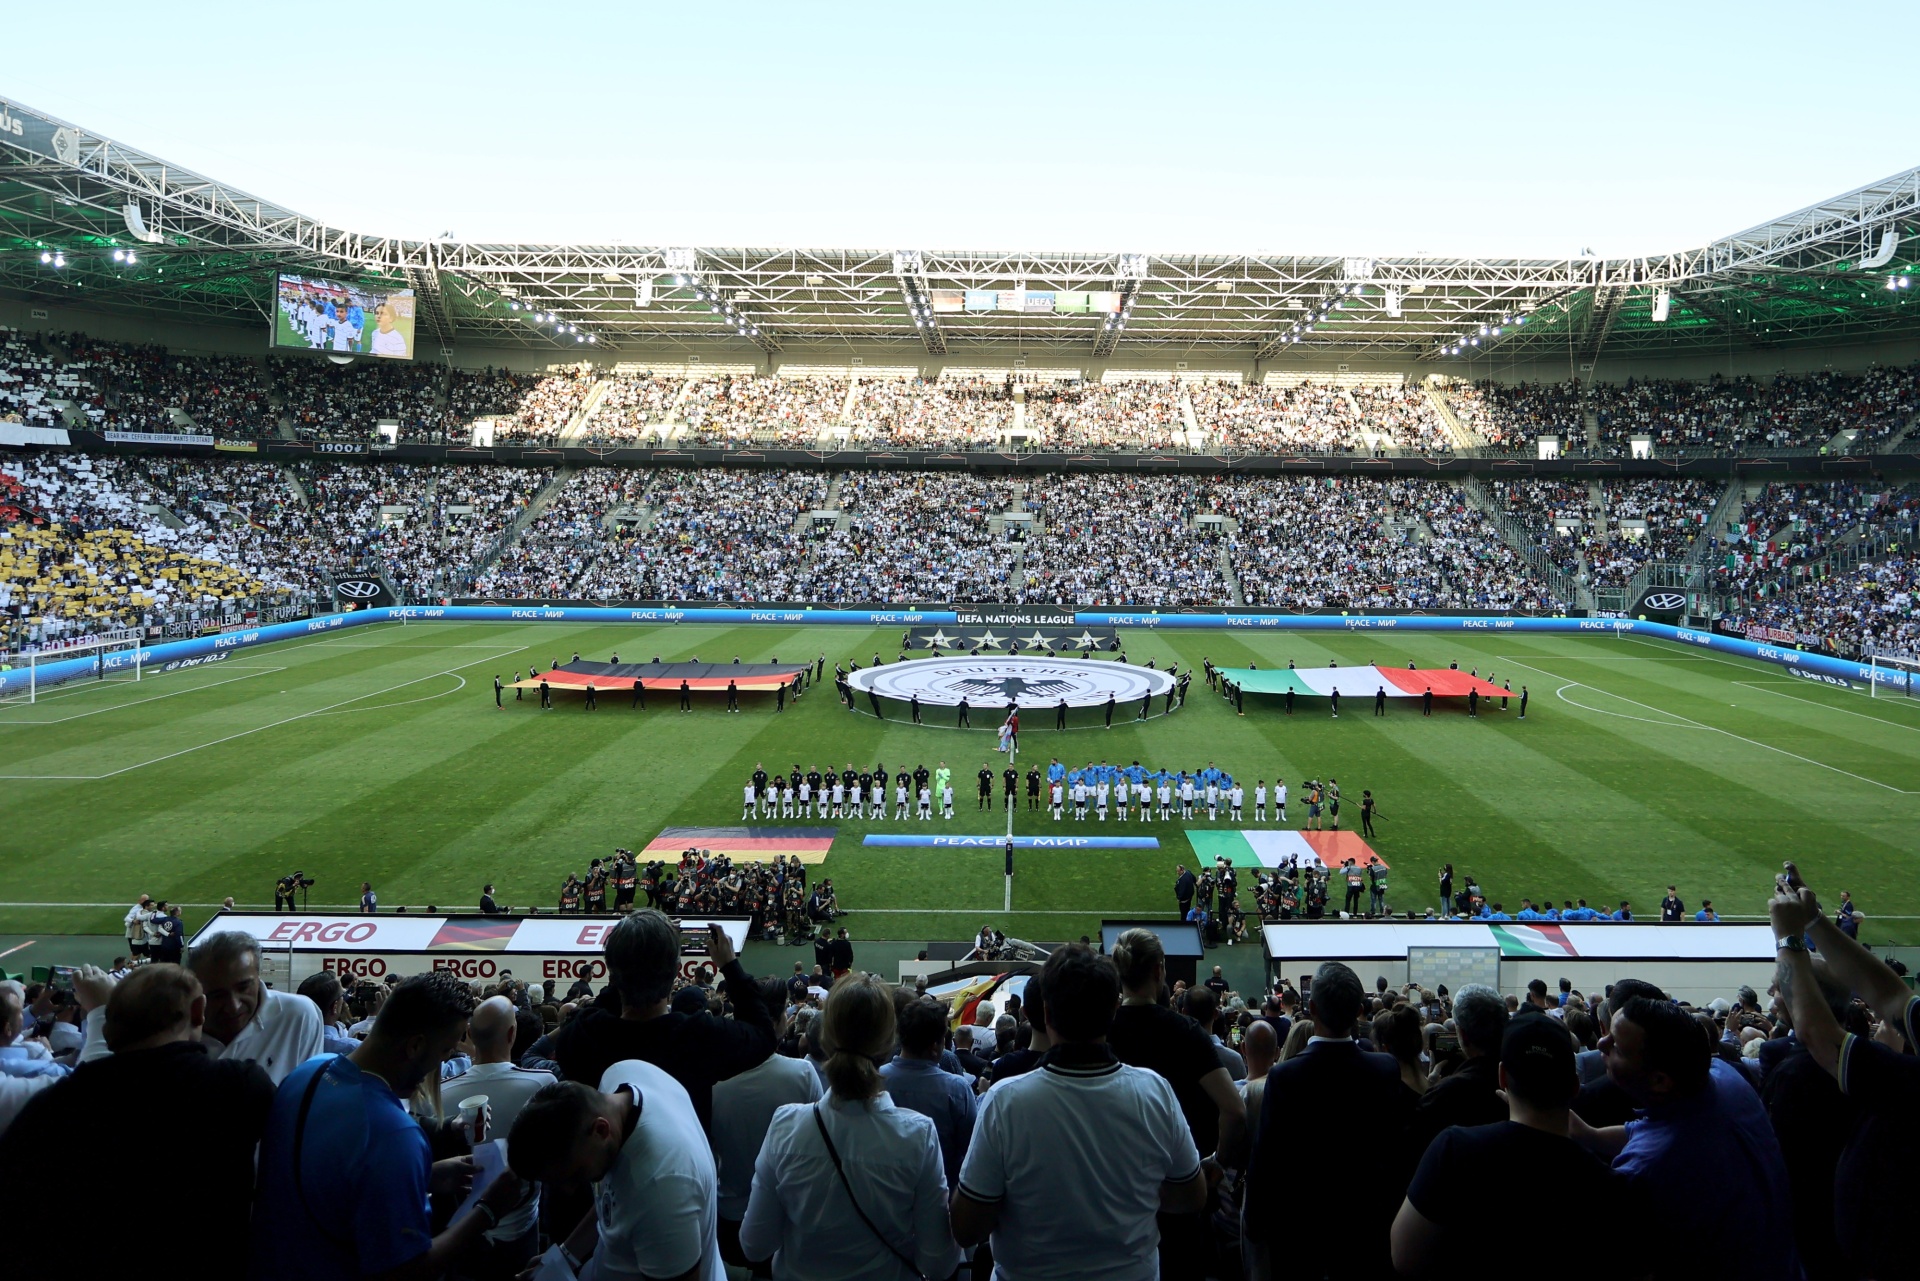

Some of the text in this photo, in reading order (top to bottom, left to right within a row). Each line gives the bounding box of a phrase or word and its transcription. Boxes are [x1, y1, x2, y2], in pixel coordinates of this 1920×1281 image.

[1027, 298, 1051, 306] UEFA
[320, 443, 353, 452] 1900
[389, 609, 417, 617] PEACE
[512, 610, 537, 618] PEACE
[632, 611, 657, 619] PEACE
[665, 612, 684, 620] МИР
[784, 613, 803, 621] МИР
[308, 621, 326, 630] PEACE
[330, 618, 343, 627] МИР
[957, 615, 1074, 624] UEFA NATIONS LEAGUE
[1108, 616, 1133, 624] PEACE
[1141, 617, 1161, 625] МИР
[1260, 618, 1279, 626] МИР
[1378, 619, 1397, 627] МИР
[1463, 620, 1487, 628] PEACE
[1580, 621, 1605, 629] PEACE
[215, 636, 236, 648] PEACE
[243, 632, 259, 642] МИР
[1677, 630, 1693, 641] PEACE
[1697, 635, 1710, 644] МИР
[1769, 628, 1795, 643] URBACH
[1758, 647, 1778, 660] PEACE
[1783, 653, 1799, 663] МИР
[94, 656, 122, 670] PACE
[180, 658, 201, 668] Der
[202, 652, 227, 663] ID.5
[934, 667, 1089, 677] DEUTSCHER
[1802, 670, 1822, 682] Der
[1823, 675, 1848, 687] ID.5
[933, 838, 1006, 846] PEACE
[1033, 838, 1089, 846] МИР
[268, 921, 377, 943] ERGO
[322, 958, 386, 977] ERGO
[433, 959, 496, 978] ERGO
[543, 960, 606, 978] ERGO
